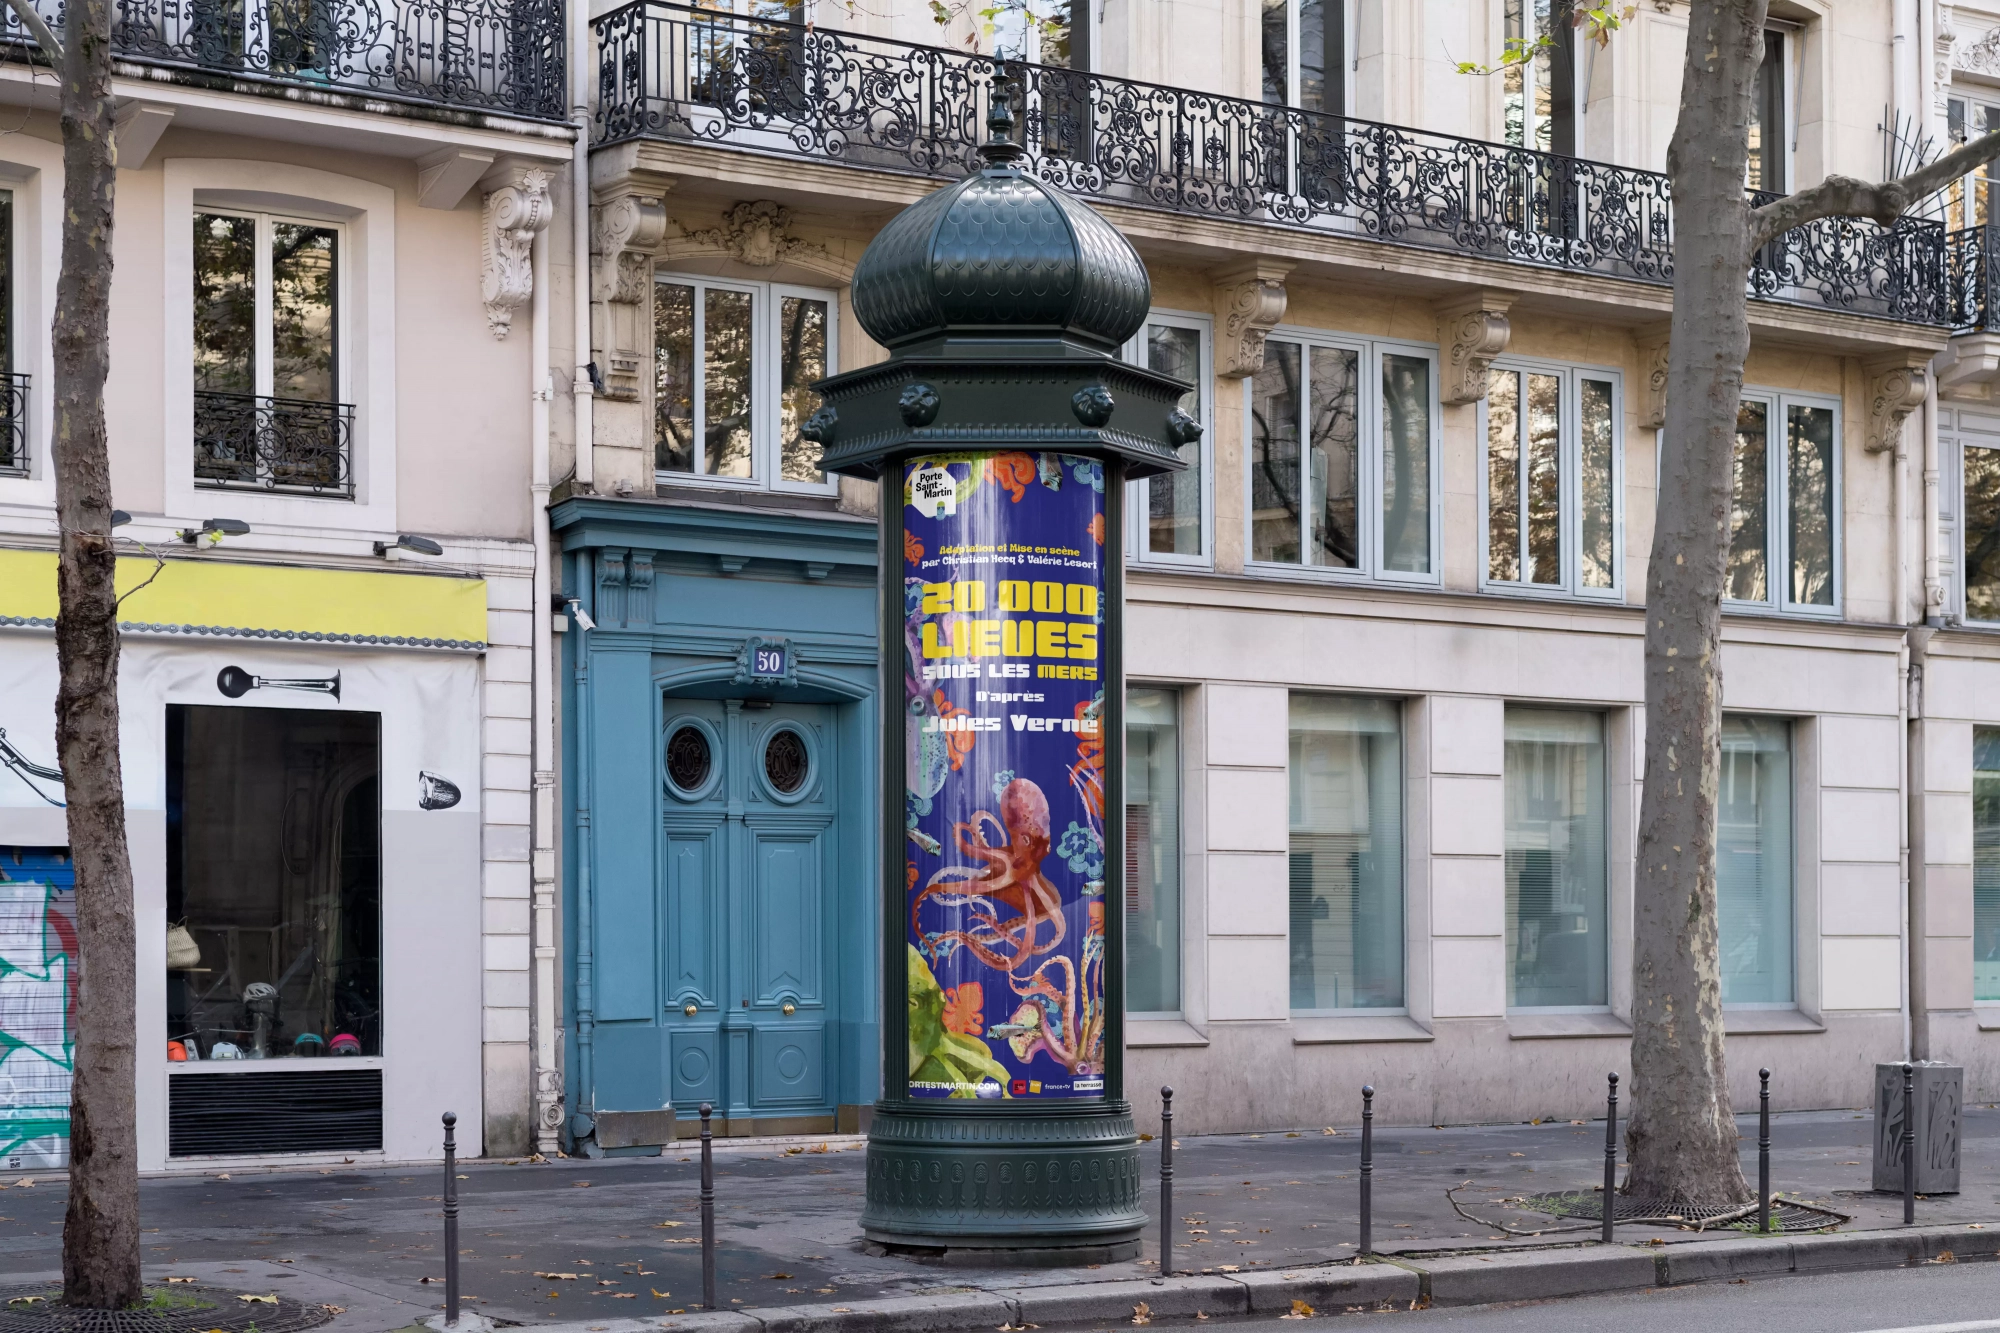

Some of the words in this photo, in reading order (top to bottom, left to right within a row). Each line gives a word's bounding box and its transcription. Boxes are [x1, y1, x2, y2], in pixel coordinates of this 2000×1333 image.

[920, 472, 943, 482] Porte
[916, 481, 943, 492] Saint-
[924, 487, 952, 499] Martin
[939, 543, 995, 555] Adaptation
[997, 543, 1007, 553] et
[1009, 543, 1033, 553] Mise
[1035, 546, 1048, 554] en
[1049, 545, 1080, 556] scène
[922, 559, 940, 570] par
[942, 555, 989, 565] Christian
[991, 554, 1016, 565] Hecq
[1018, 554, 1025, 564] &
[1027, 555, 1062, 566] Valérie
[1064, 557, 1098, 570] Lesort
[922, 580, 985, 614] 20
[998, 580, 1098, 616] 000
[922, 620, 1098, 660] LIEUES
[758, 651, 780, 672] 50
[922, 664, 981, 680] SOUS
[988, 664, 1031, 678] LES
[1037, 664, 1098, 681] MERS
[976, 690, 1045, 703] D'après
[922, 715, 1002, 732] Jules
[1010, 714, 1098, 733] Verne
